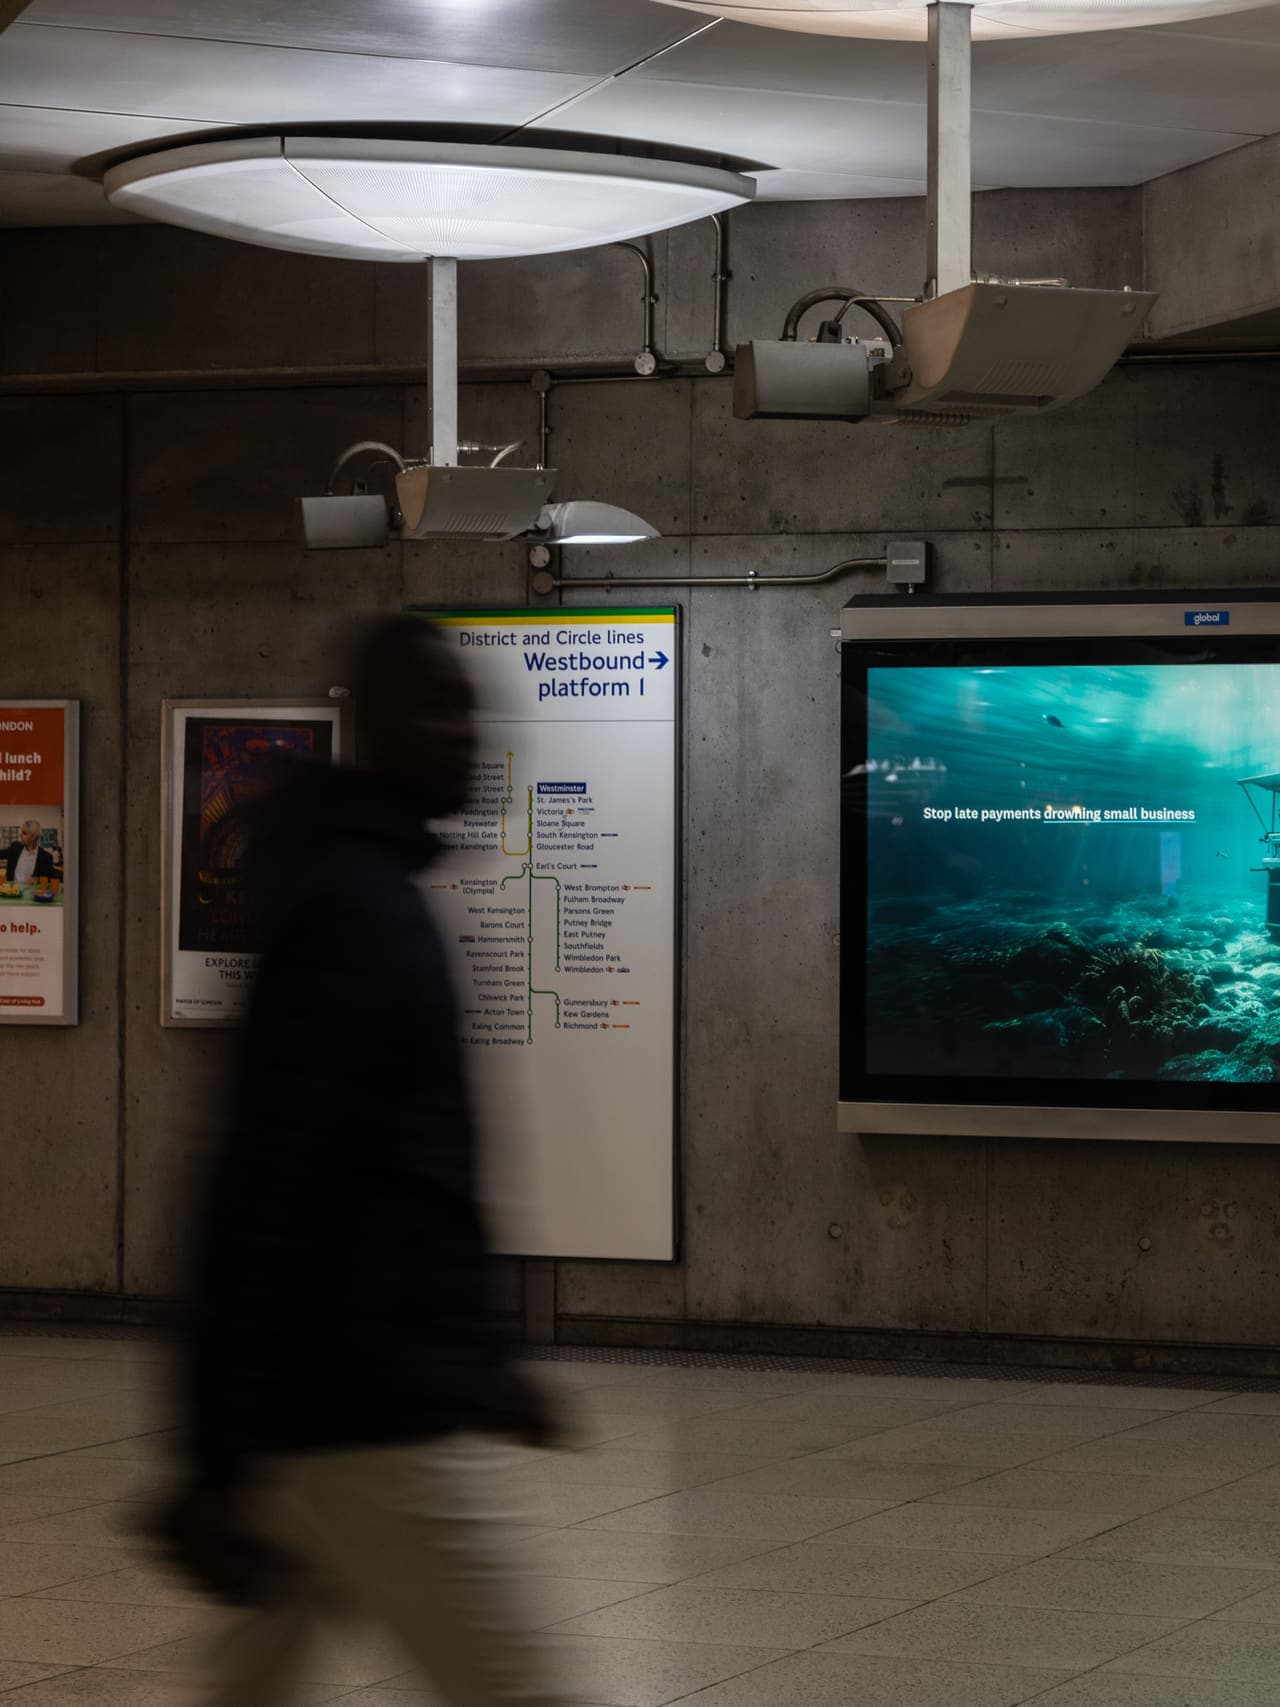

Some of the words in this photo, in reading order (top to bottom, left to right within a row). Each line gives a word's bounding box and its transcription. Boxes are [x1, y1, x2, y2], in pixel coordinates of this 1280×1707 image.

[1194, 612, 1220, 625] global
[459, 630, 518, 647] District
[523, 630, 550, 646] and
[556, 630, 602, 647] Circle
[607, 630, 645, 646] lines
[525, 650, 646, 672] Westbound
[538, 677, 631, 702] platform
[0, 721, 33, 731] NDON
[5, 752, 42, 764] lunch
[482, 762, 504, 770] Square
[539, 784, 585, 793] Westminster
[924, 807, 951, 822] Stop
[955, 807, 978, 819] late
[981, 809, 1041, 822] payments
[1044, 807, 1101, 822] drowning
[1104, 808, 1138, 819] small
[1141, 808, 1195, 820] business
[562, 820, 585, 828] Square
[440, 832, 465, 840] Notting
[559, 831, 598, 840] Kensington
[460, 844, 498, 852] Kensington
[536, 862, 555, 870] Earl's
[557, 862, 577, 870] Court
[461, 879, 498, 887] Kensington
[463, 887, 494, 896] (Olympia)
[585, 884, 619, 893] Brompton
[564, 895, 589, 905] Fulham
[591, 895, 625, 905] Broadway
[468, 907, 485, 915] West
[487, 907, 525, 915] Kensington
[564, 907, 590, 915] Parsons
[592, 907, 614, 915] Green
[480, 921, 502, 929] Barons
[503, 921, 525, 929] Court
[564, 919, 588, 927] Putney
[590, 919, 612, 927] Bridge
[11, 922, 40, 936] help.
[564, 930, 578, 939] East
[581, 930, 606, 939] Putney
[564, 942, 604, 950] Southfields
[466, 950, 507, 958] Ravenscourt
[509, 950, 524, 958] Park
[564, 954, 603, 962] Wimbledon
[606, 954, 620, 962] Park
[205, 958, 249, 968] EXPLORE
[564, 966, 604, 974] Wimbledon
[219, 970, 241, 979] THIS
[473, 979, 501, 987] Turnham
[504, 979, 525, 987] Green
[564, 999, 608, 1008] Gunnersbury
[472, 1023, 493, 1031] Ealing
[495, 1023, 525, 1031] Common
[564, 1022, 597, 1030] Richmond
[470, 1038, 490, 1046] Ealing
[493, 1038, 524, 1046] Broadway
